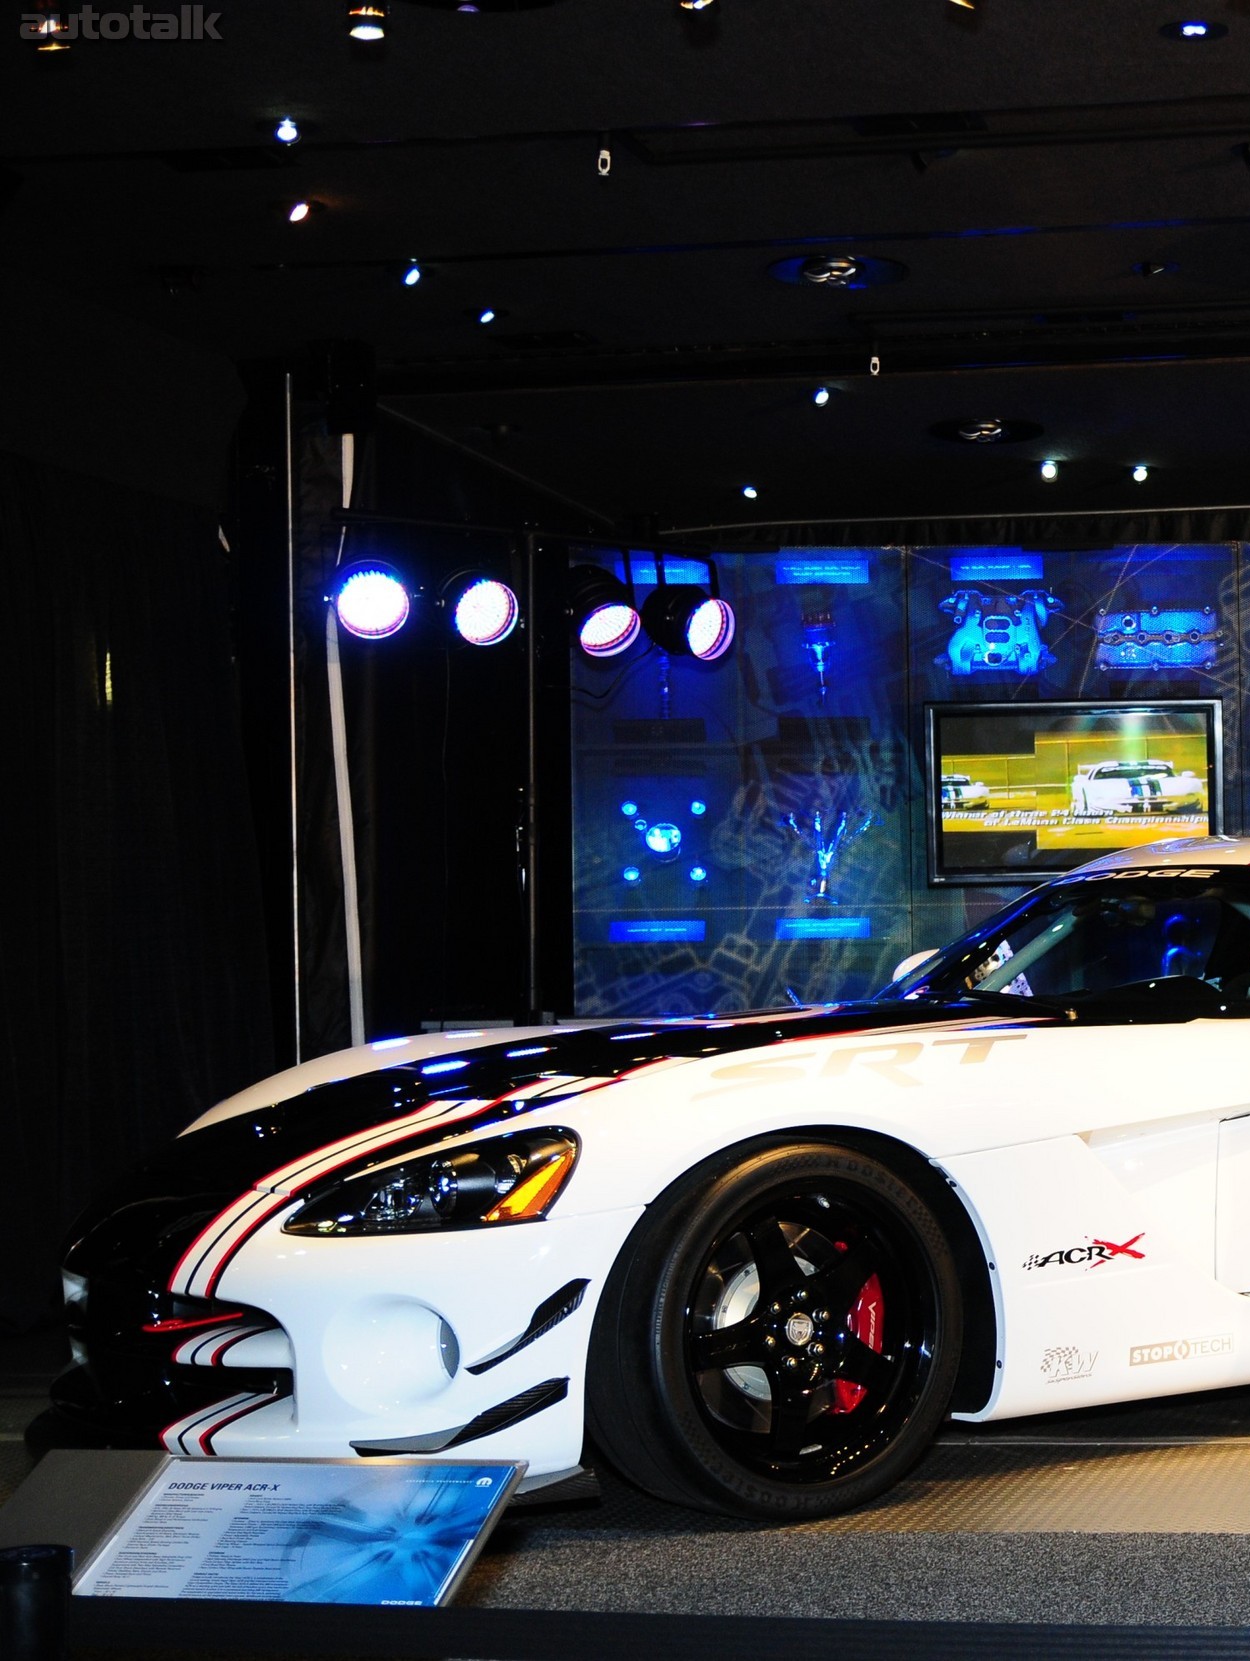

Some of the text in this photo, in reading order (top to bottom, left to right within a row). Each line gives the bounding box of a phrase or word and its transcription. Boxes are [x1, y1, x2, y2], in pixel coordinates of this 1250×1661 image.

[1050, 868, 1221, 887] DODGE
[690, 1034, 1027, 1101] SRT
[168, 1482, 281, 1492] DODGE VIPER ACR-X
